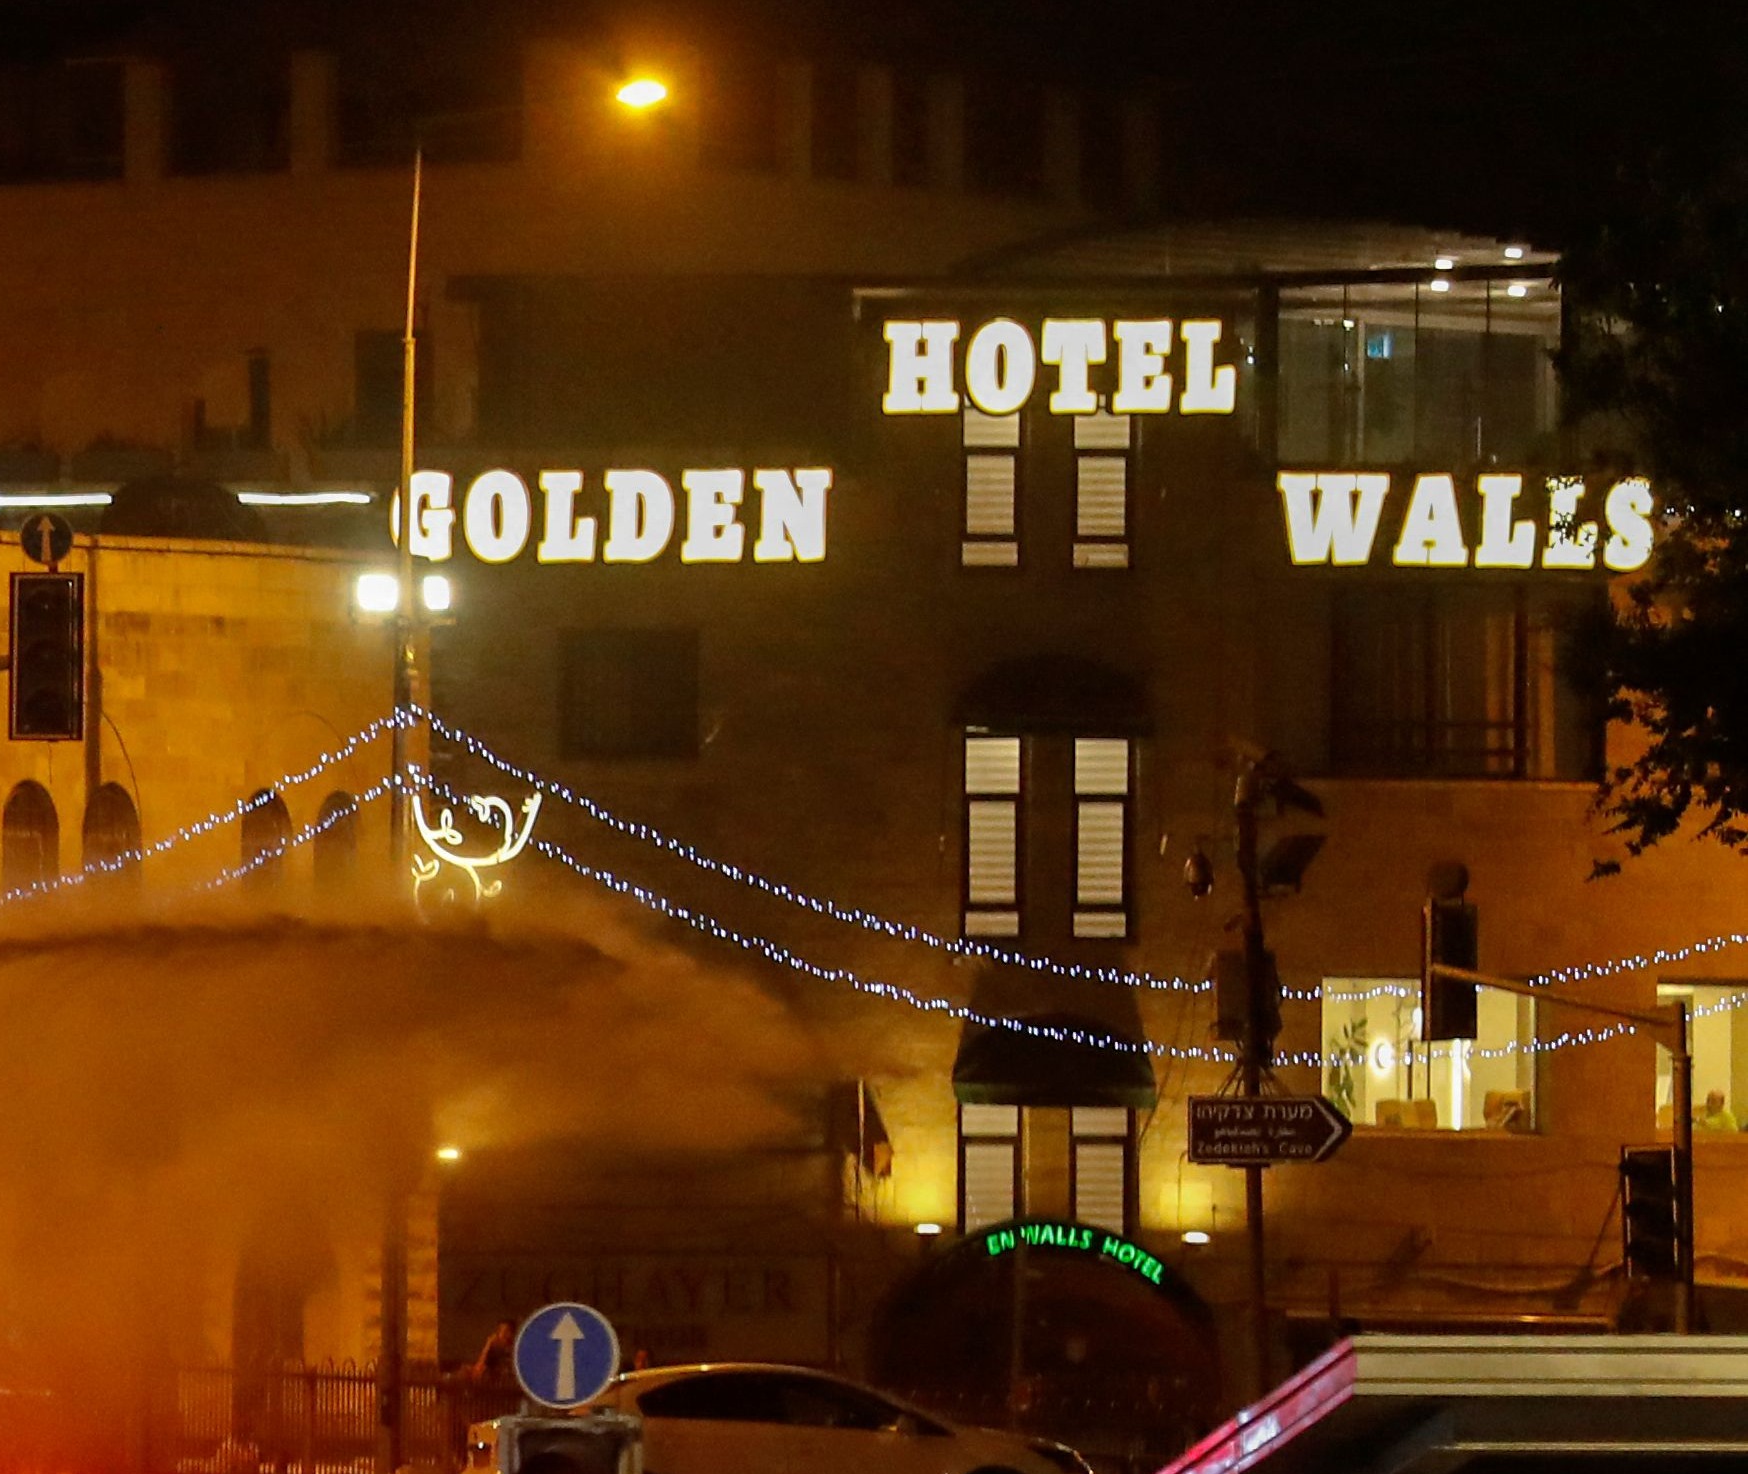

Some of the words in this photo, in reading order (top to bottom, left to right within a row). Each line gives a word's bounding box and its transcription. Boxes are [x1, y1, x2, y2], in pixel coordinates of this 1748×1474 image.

[882, 317, 1238, 416] HOTEL
[390, 468, 832, 563] GOLDEN
[1277, 471, 1655, 571] WALLS
[1263, 1104, 1313, 1121] מערת
[1279, 1142, 1313, 1155] Cave
[1020, 1224, 1093, 1250] WALLS
[1102, 1235, 1165, 1285] HOTEL
